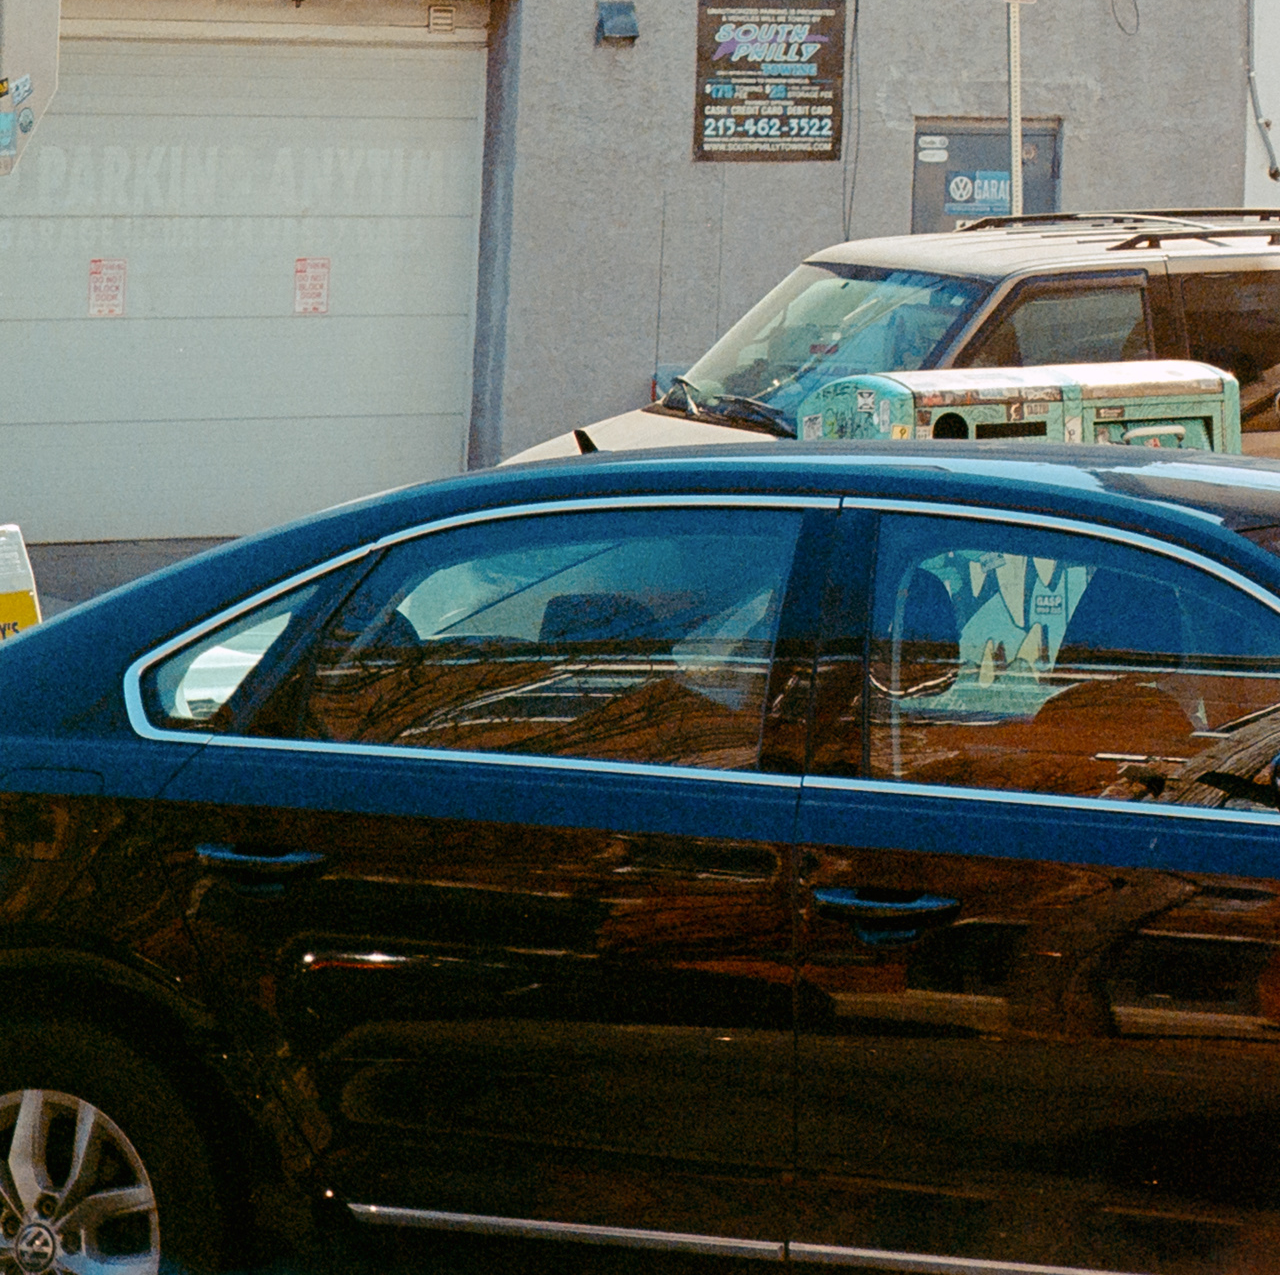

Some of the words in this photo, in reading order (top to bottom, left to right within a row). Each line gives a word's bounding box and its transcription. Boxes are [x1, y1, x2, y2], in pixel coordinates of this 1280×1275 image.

[715, 23, 810, 43] SOUTH
[731, 43, 821, 62] PHILLY
[704, 117, 833, 136] 215-462-3522
